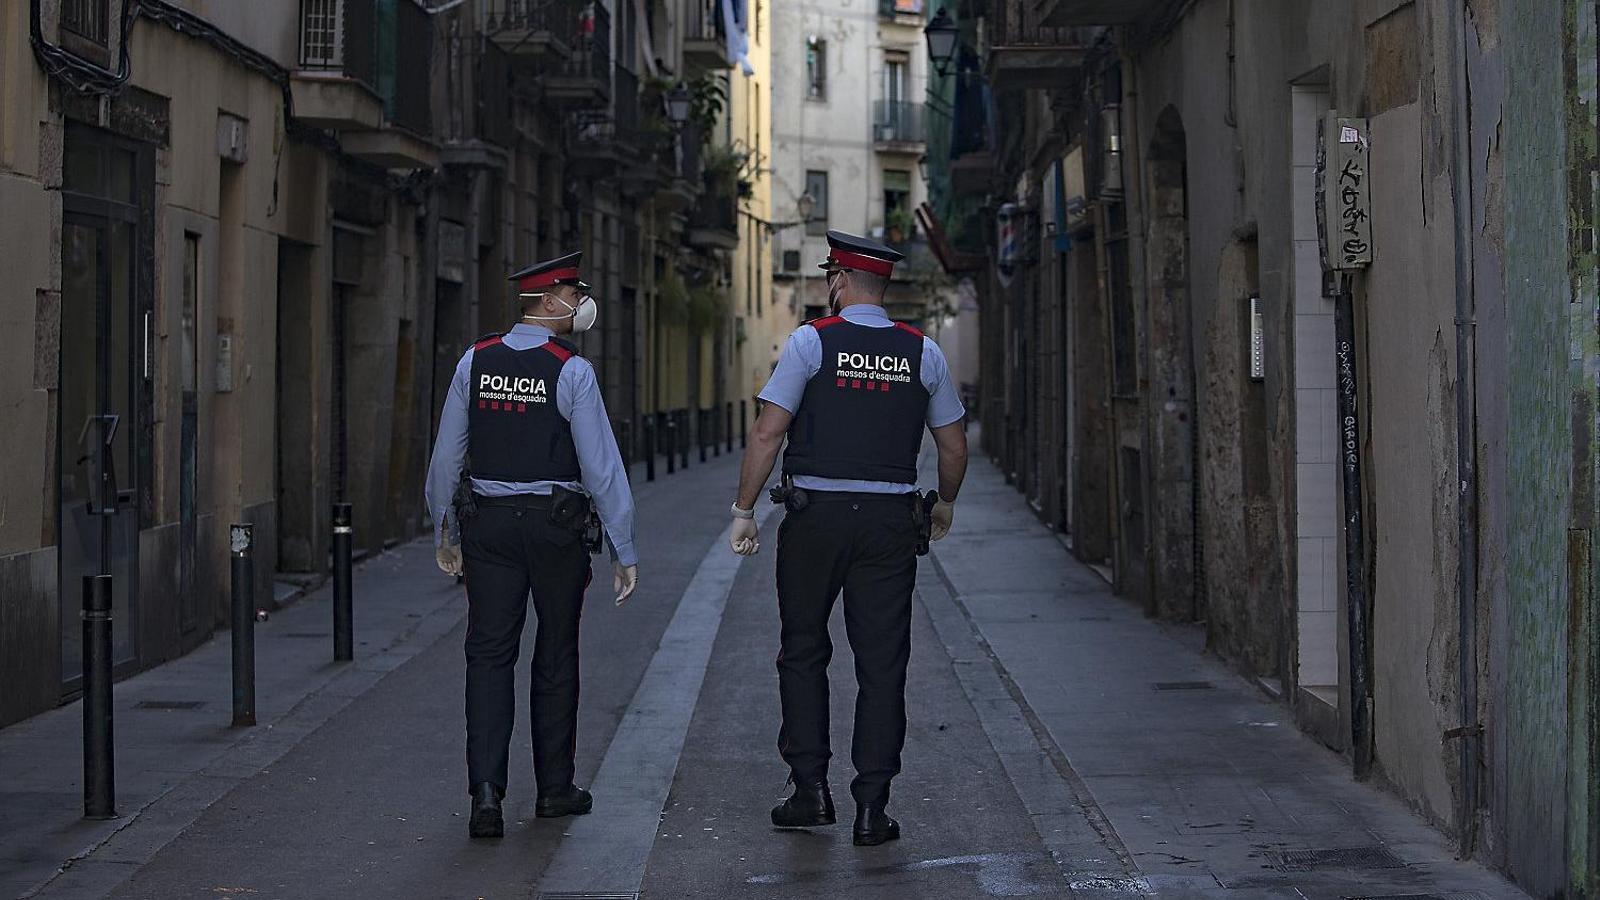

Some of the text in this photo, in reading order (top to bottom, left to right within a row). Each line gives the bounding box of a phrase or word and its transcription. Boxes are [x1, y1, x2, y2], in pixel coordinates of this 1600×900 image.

[837, 352, 911, 373] POLICIA
[479, 373, 547, 395] POLICIA
[836, 370, 911, 383] mossos d'esquadra
[479, 391, 547, 403] mossos d'esquadra
